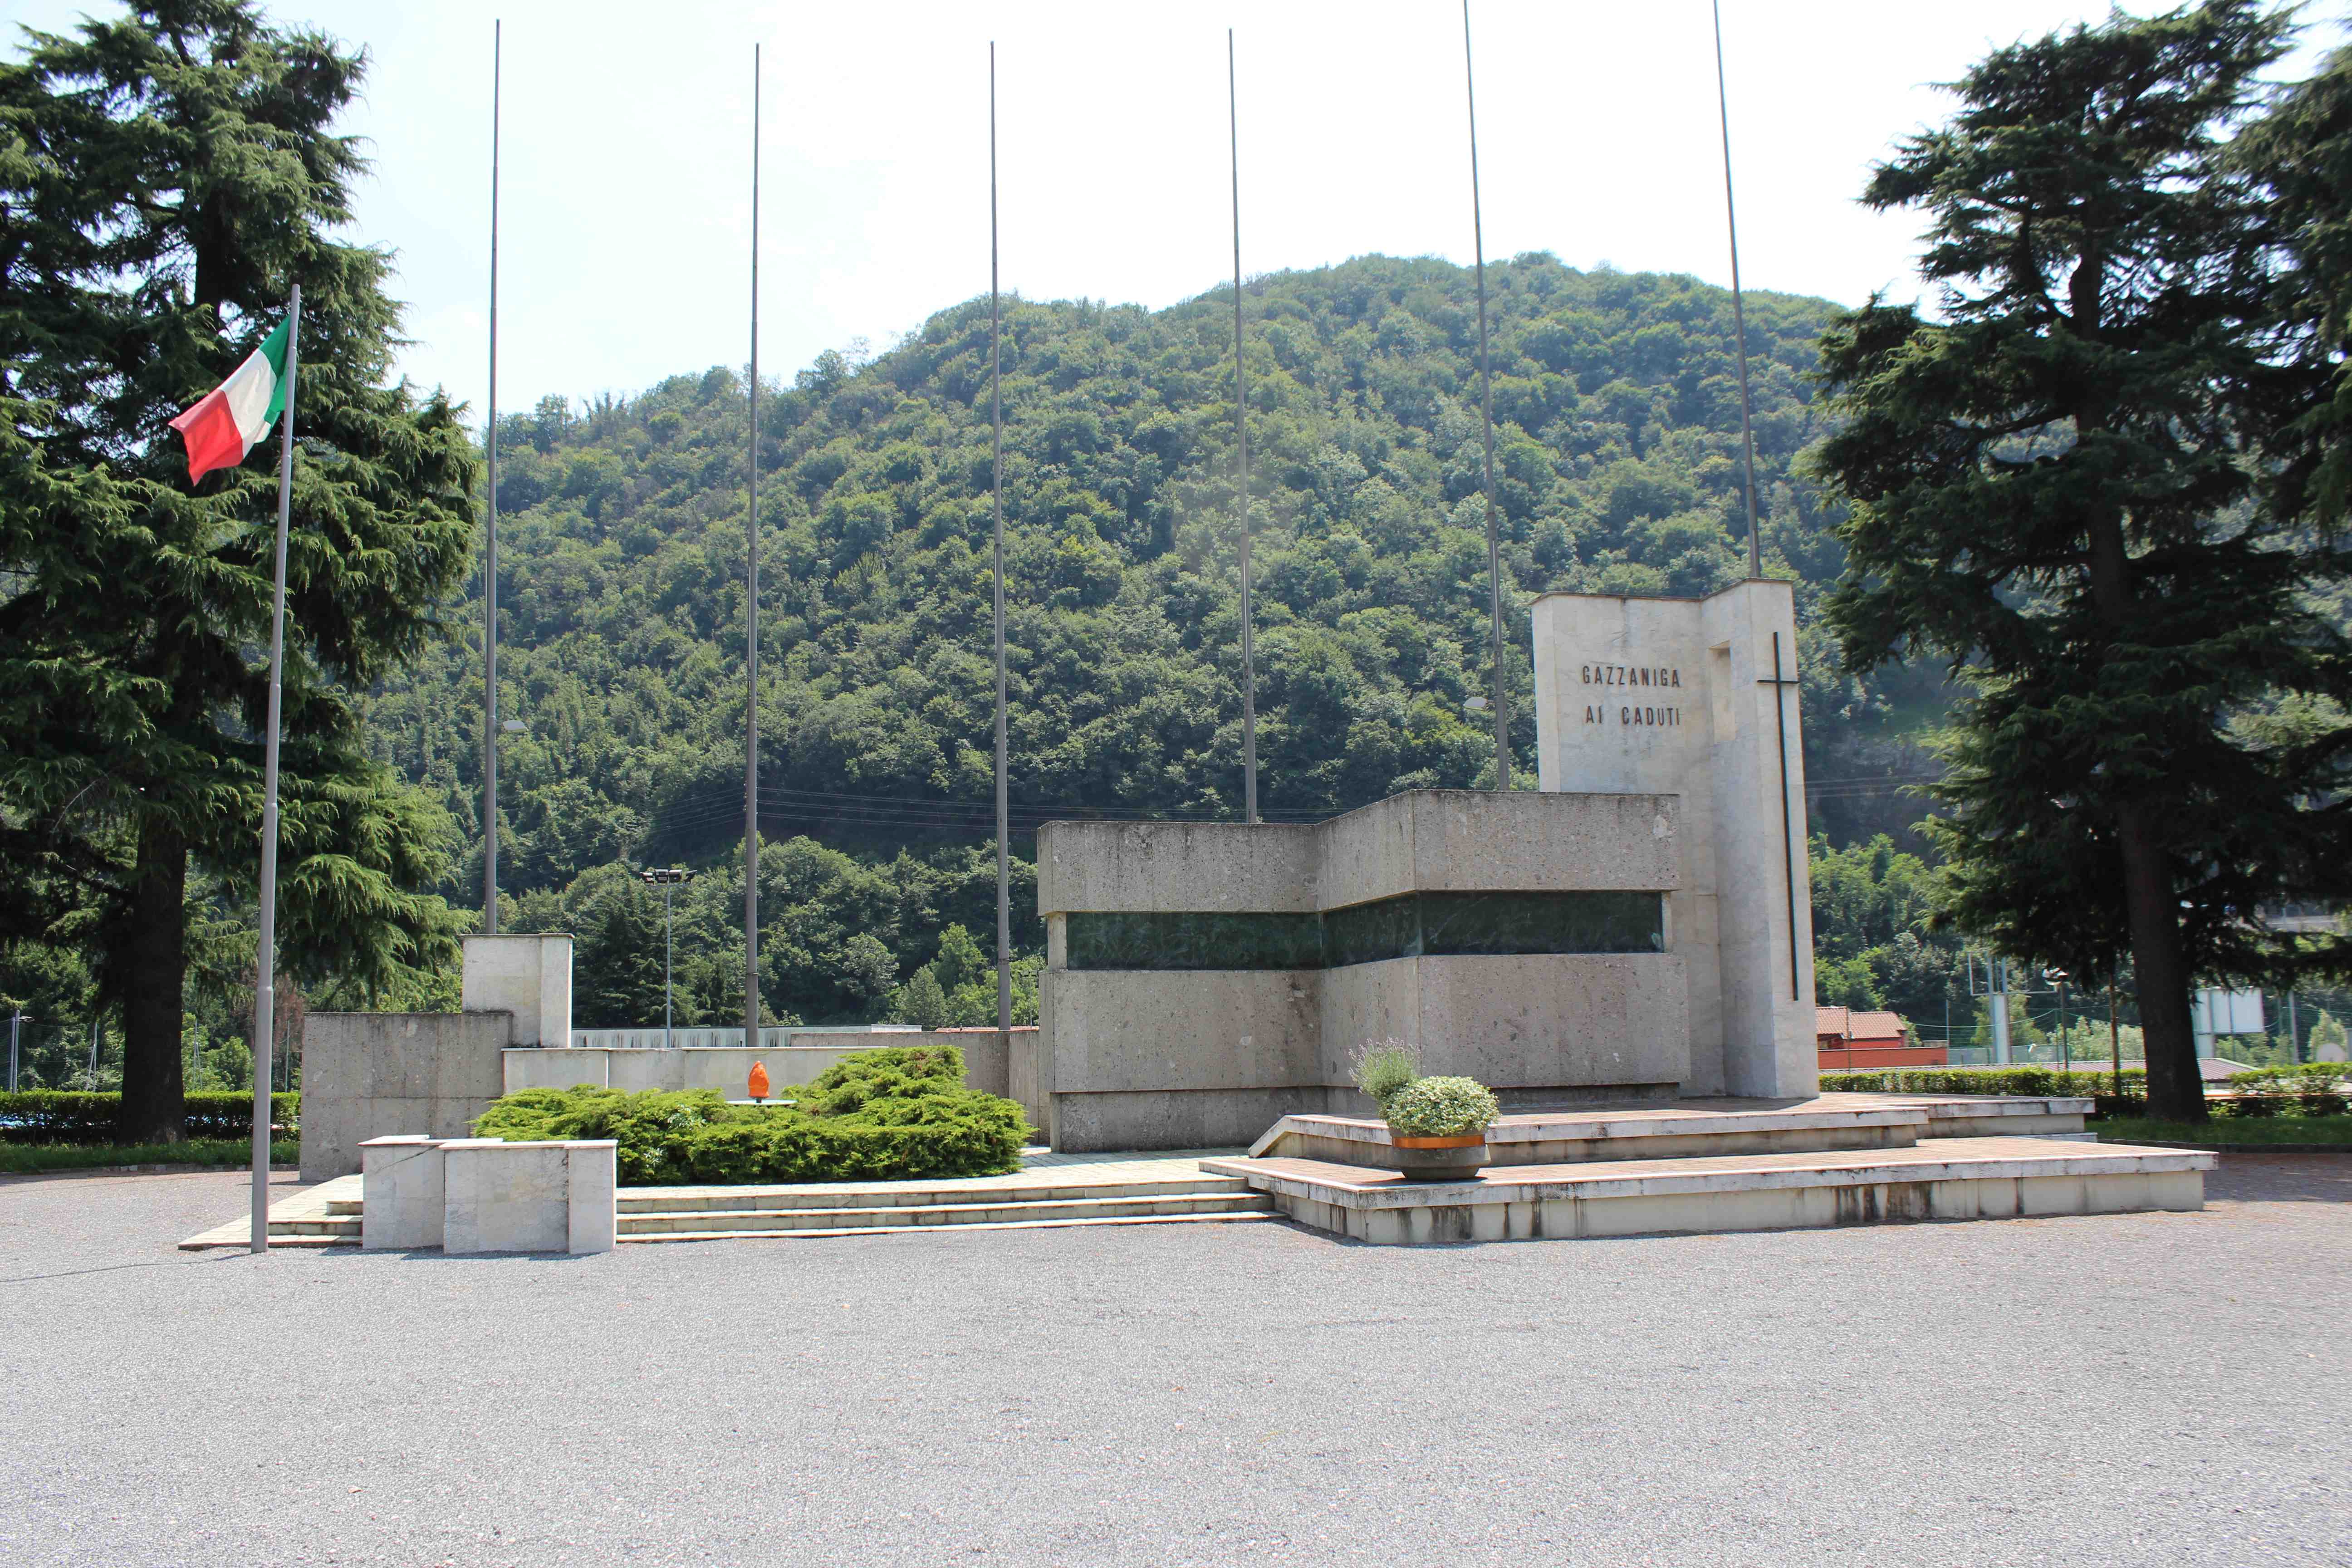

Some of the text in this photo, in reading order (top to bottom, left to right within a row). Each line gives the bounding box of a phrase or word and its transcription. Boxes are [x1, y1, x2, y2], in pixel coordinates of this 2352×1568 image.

[1583, 666, 1680, 687] GAZZANIGA
[1586, 706, 1680, 726] AI CADUTI
